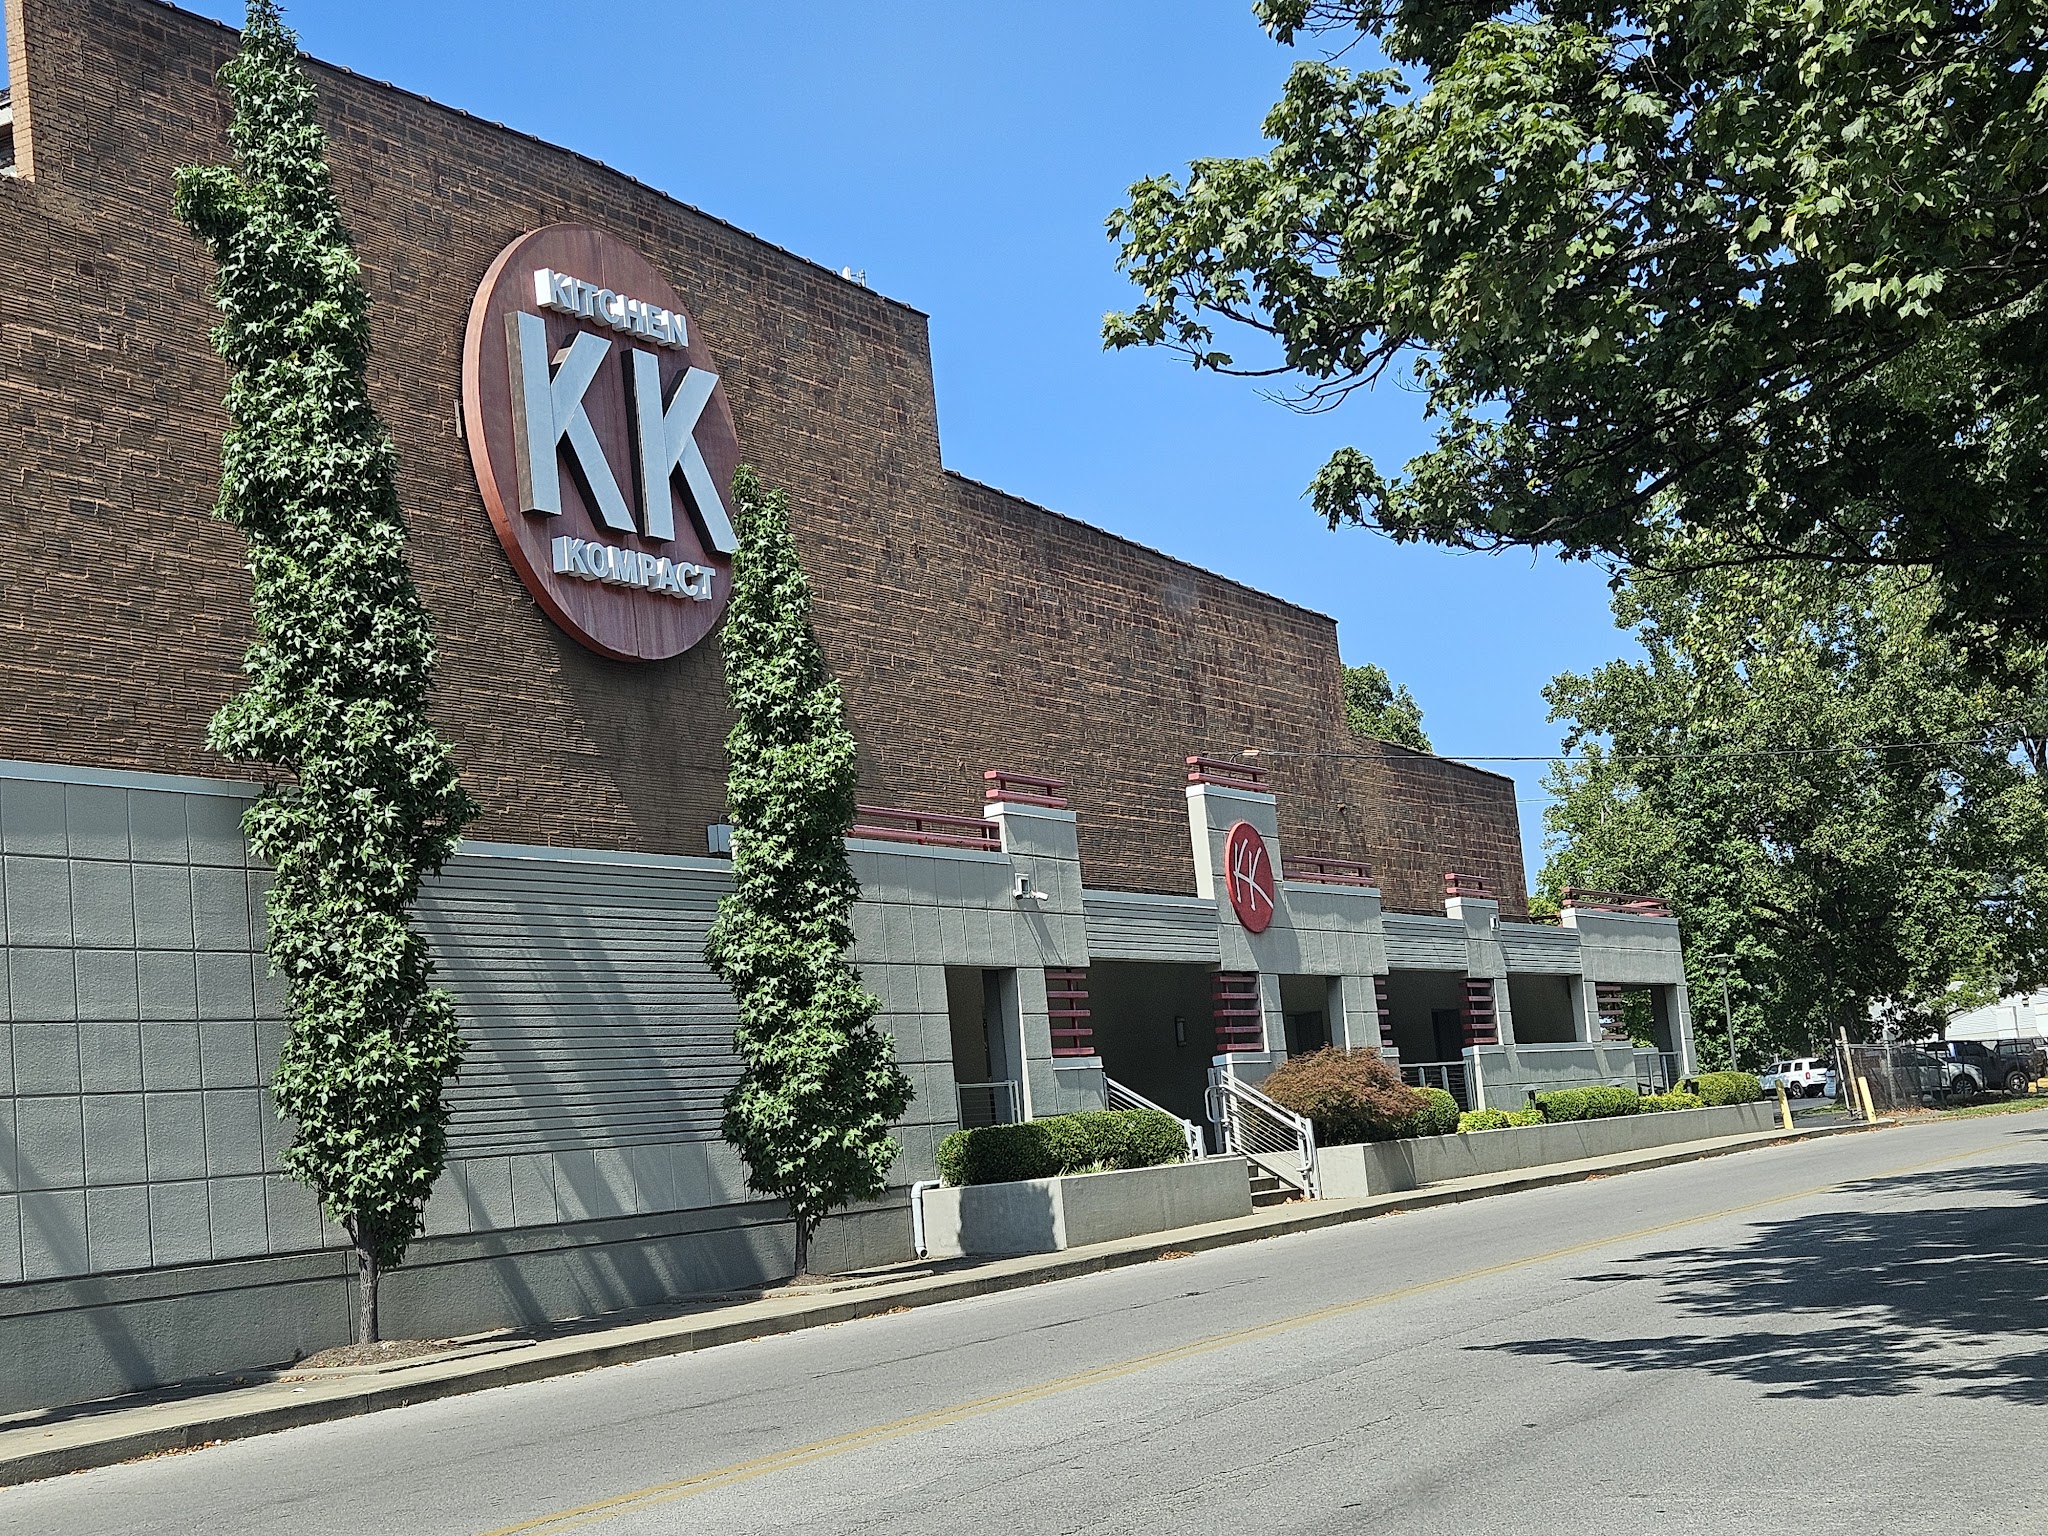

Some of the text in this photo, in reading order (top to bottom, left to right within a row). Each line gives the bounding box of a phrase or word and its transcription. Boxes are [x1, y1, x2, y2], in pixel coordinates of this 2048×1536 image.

[534, 267, 690, 350] KITCHEN
[505, 310, 740, 554] KK
[552, 535, 716, 601] KOMPACT
